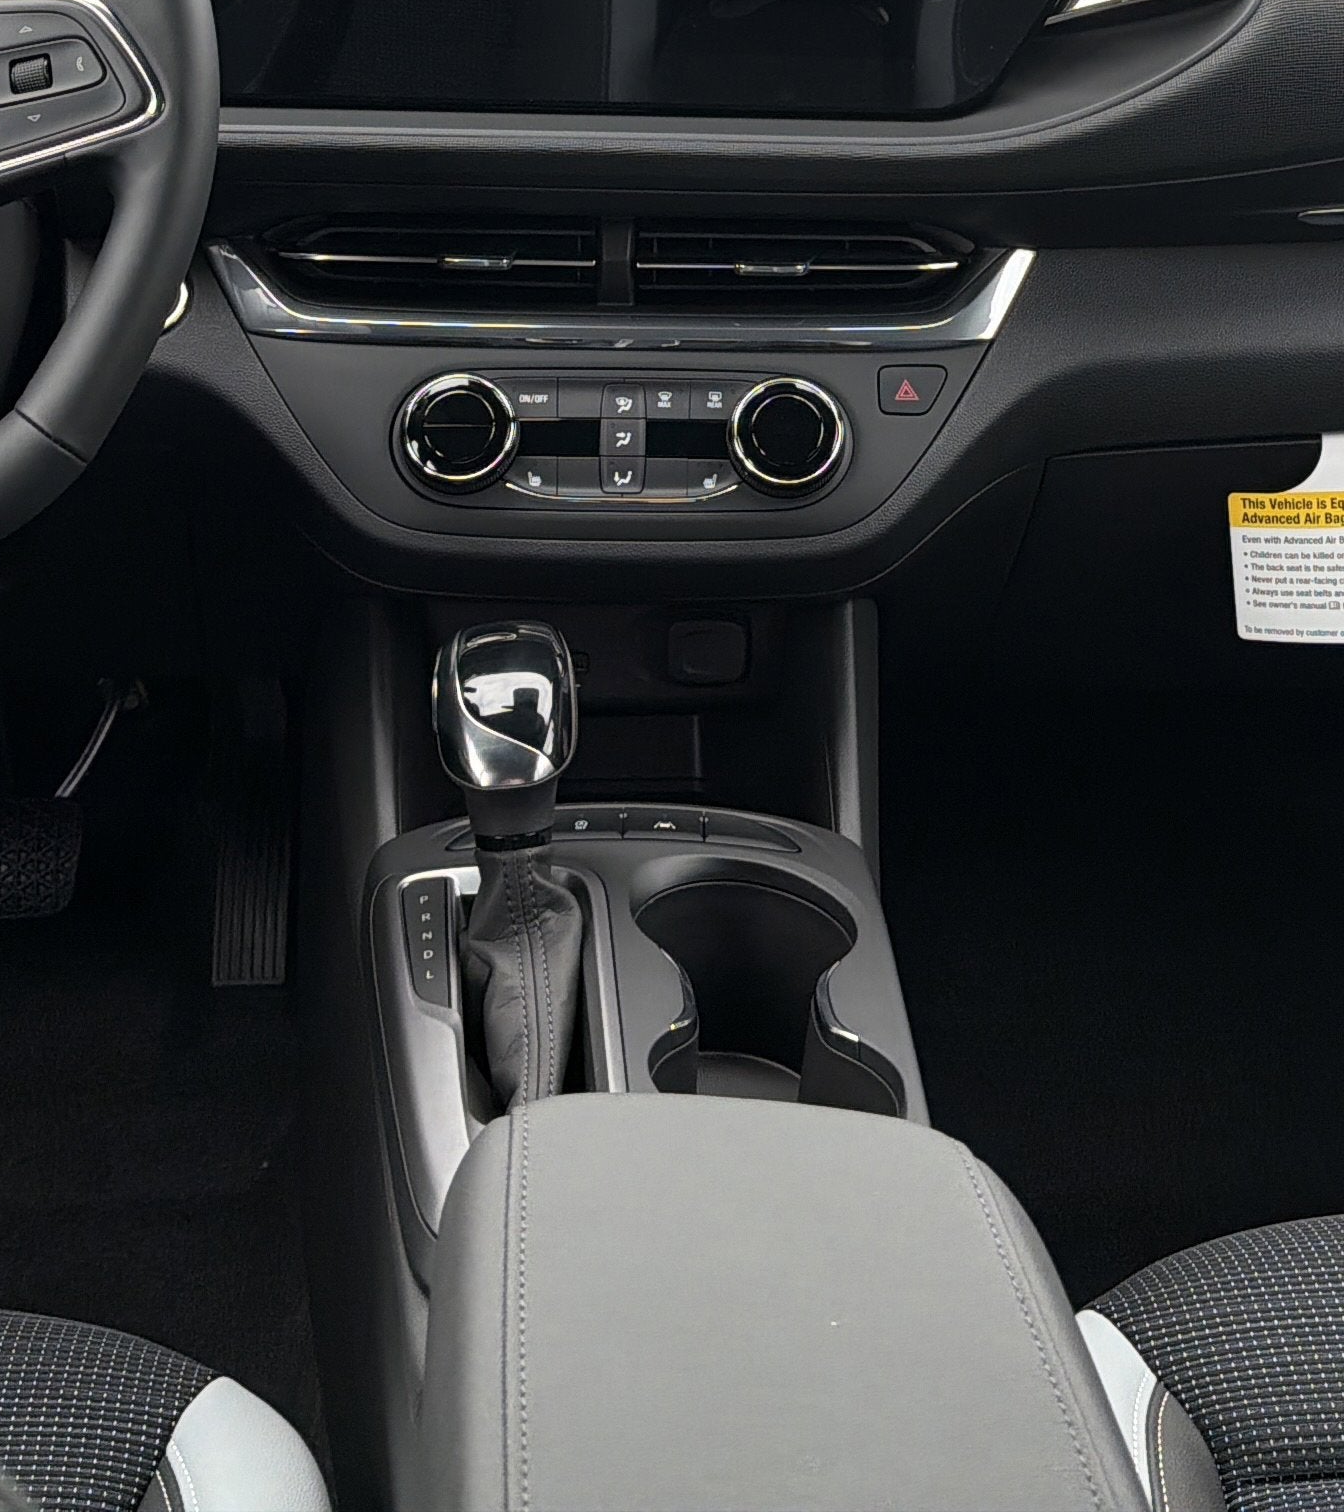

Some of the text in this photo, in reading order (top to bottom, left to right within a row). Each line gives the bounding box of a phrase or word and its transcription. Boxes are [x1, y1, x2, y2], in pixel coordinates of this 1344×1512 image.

[518, 394, 549, 405] ON/OFF
[657, 401, 672, 409] MAX
[707, 401, 723, 409] REAR
[1241, 497, 1267, 510] This
[1269, 497, 1313, 510] Vehicle
[1241, 511, 1301, 525] Advanced
[1304, 511, 1322, 525] Air
[1241, 534, 1262, 544] Even
[1264, 534, 1282, 544] with
[1283, 535, 1324, 545] Advanced
[1325, 535, 1337, 545] Air
[1249, 550, 1283, 559] Children
[1284, 551, 1299, 559] can
[1300, 551, 1311, 559] be
[1312, 551, 1335, 559] killed
[1250, 562, 1265, 571] The
[1266, 563, 1285, 572] back
[1285, 564, 1303, 572] seat
[1303, 564, 1312, 572] is
[1312, 564, 1325, 572] the
[1251, 575, 1273, 584] Never
[1274, 576, 1287, 585] put
[1295, 576, 1338, 587] rear-facing
[1252, 587, 1279, 597] Always
[1280, 589, 1294, 597] use
[1295, 589, 1313, 597] seat
[1313, 589, 1333, 597] belts
[1252, 599, 1267, 608] See
[1299, 601, 1327, 609] manual
[1244, 625, 1253, 634] To
[1253, 626, 1263, 634] be
[1263, 627, 1295, 636] removed
[1295, 627, 1305, 638] by
[1305, 628, 1339, 637] customer
[419, 895, 429, 904] P
[421, 912, 431, 922] R
[422, 931, 433, 940] N
[423, 950, 433, 959] D
[426, 970, 434, 979] L
